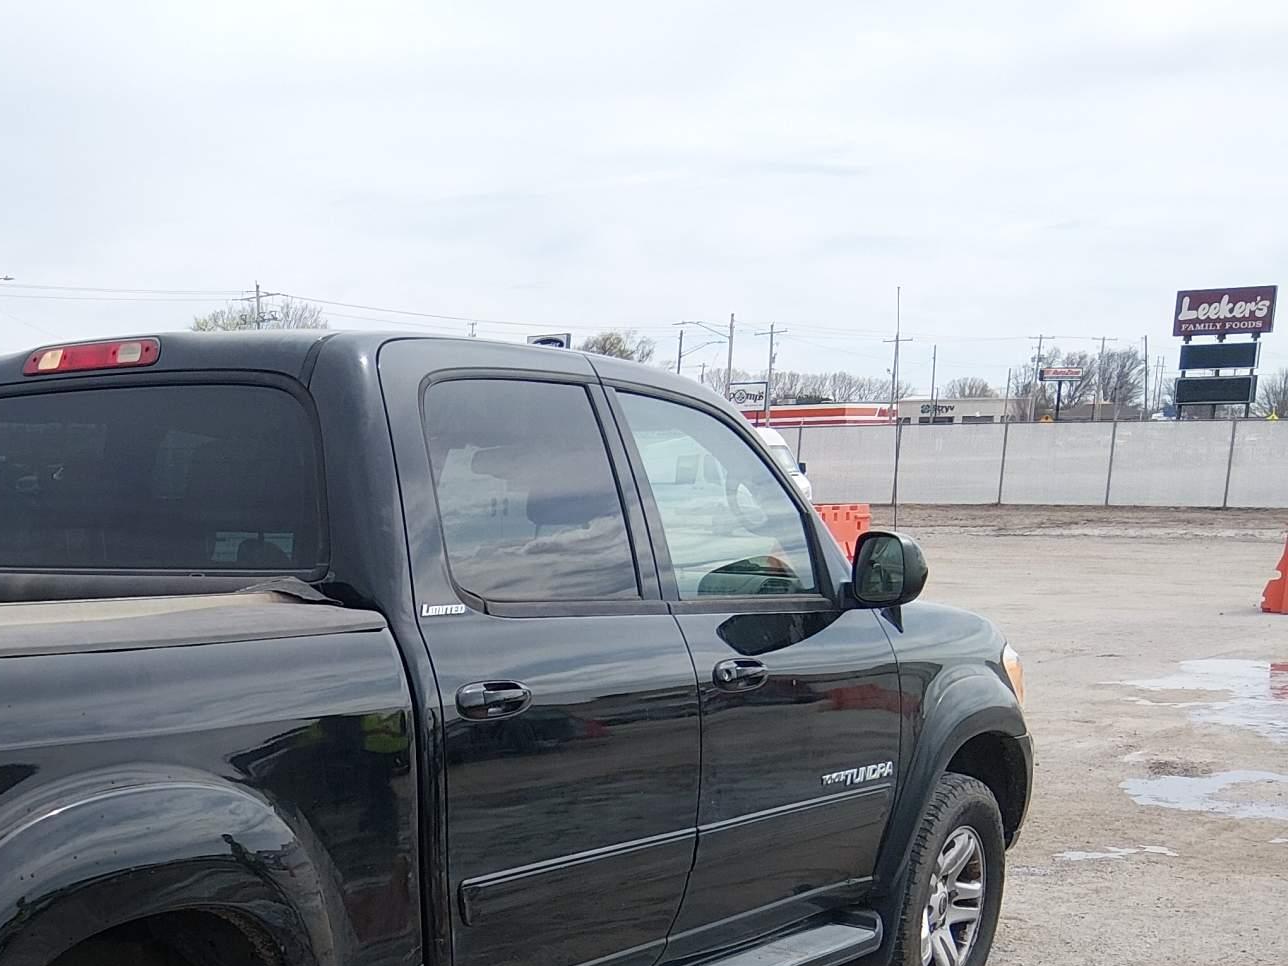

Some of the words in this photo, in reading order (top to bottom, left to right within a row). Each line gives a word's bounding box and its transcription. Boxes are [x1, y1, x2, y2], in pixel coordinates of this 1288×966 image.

[1178, 294, 1270, 321] Leeker's
[1181, 322, 1223, 331] FAMILY
[1225, 320, 1263, 330] FOODS
[845, 761, 893, 786] TUNDRA
